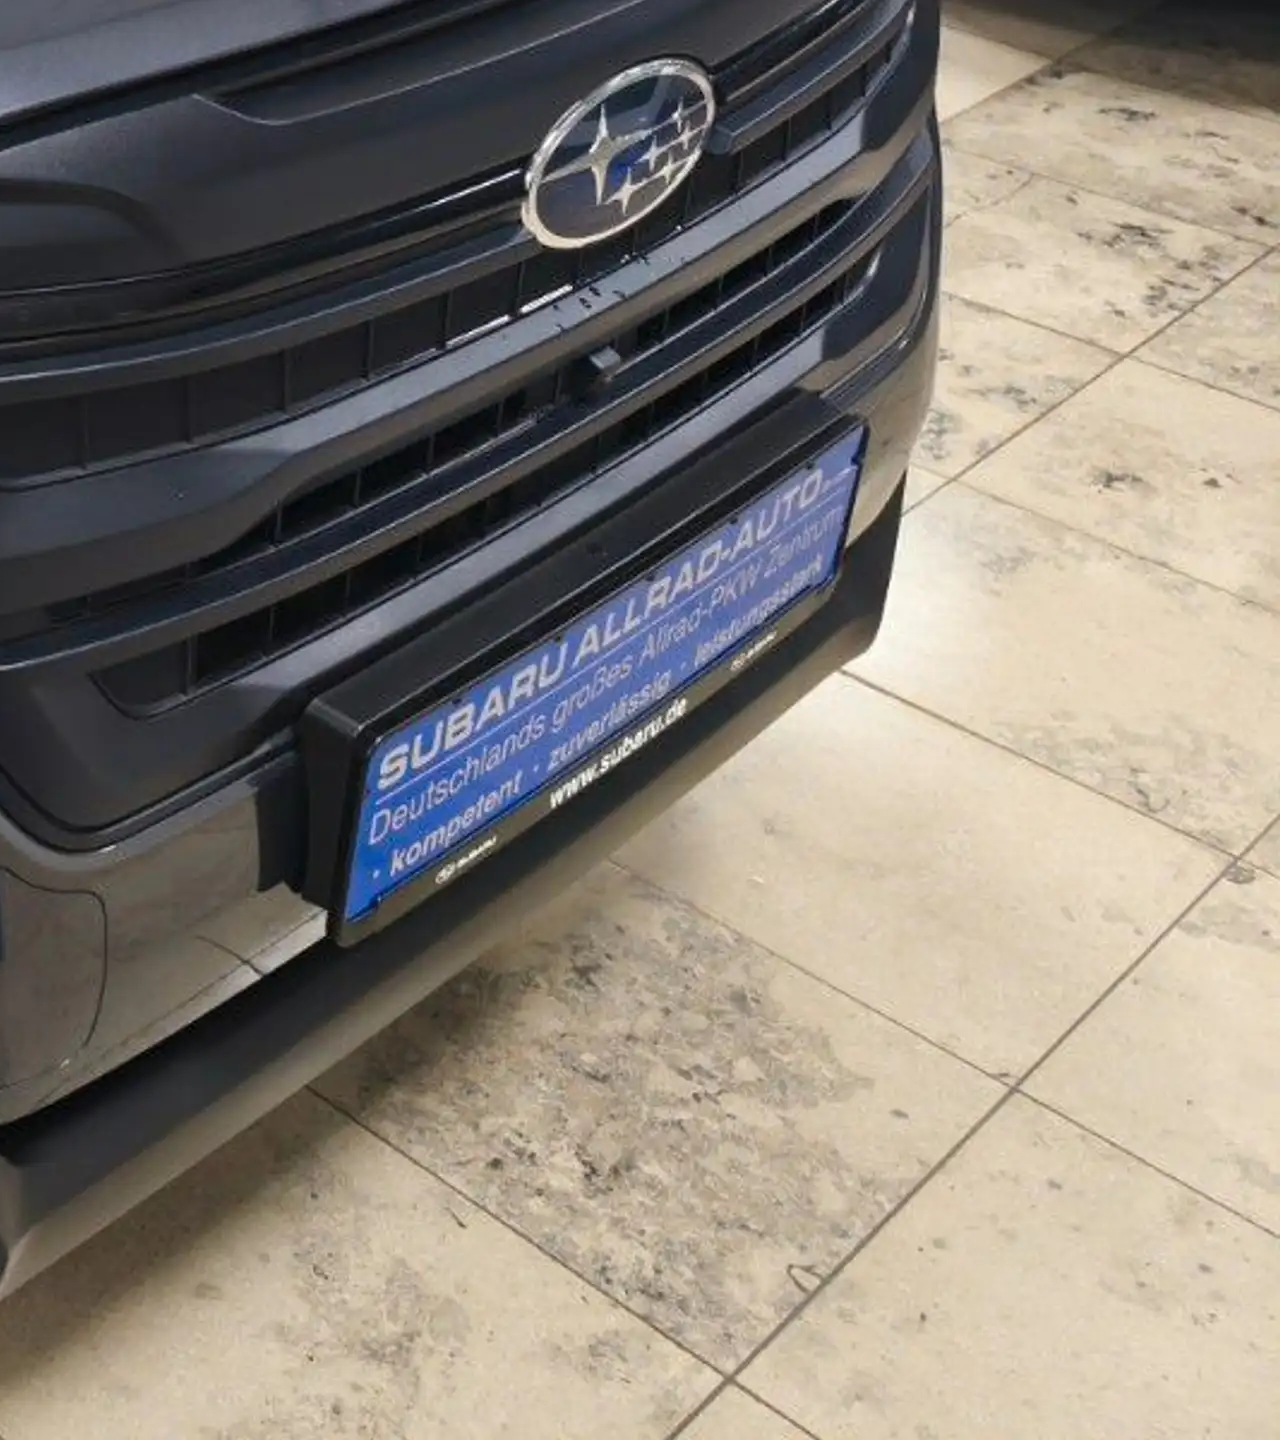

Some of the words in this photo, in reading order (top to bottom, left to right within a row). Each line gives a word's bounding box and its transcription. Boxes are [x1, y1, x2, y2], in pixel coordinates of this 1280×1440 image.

[377, 641, 569, 791] SUBARU
[572, 468, 824, 668] ALLRAD-AUTO
[368, 713, 546, 846] Deutschlands
[551, 655, 633, 733] großes
[390, 770, 523, 877] kompetent
[547, 671, 672, 773] zuverlässig
[549, 698, 688, 810] www.subaru.de
